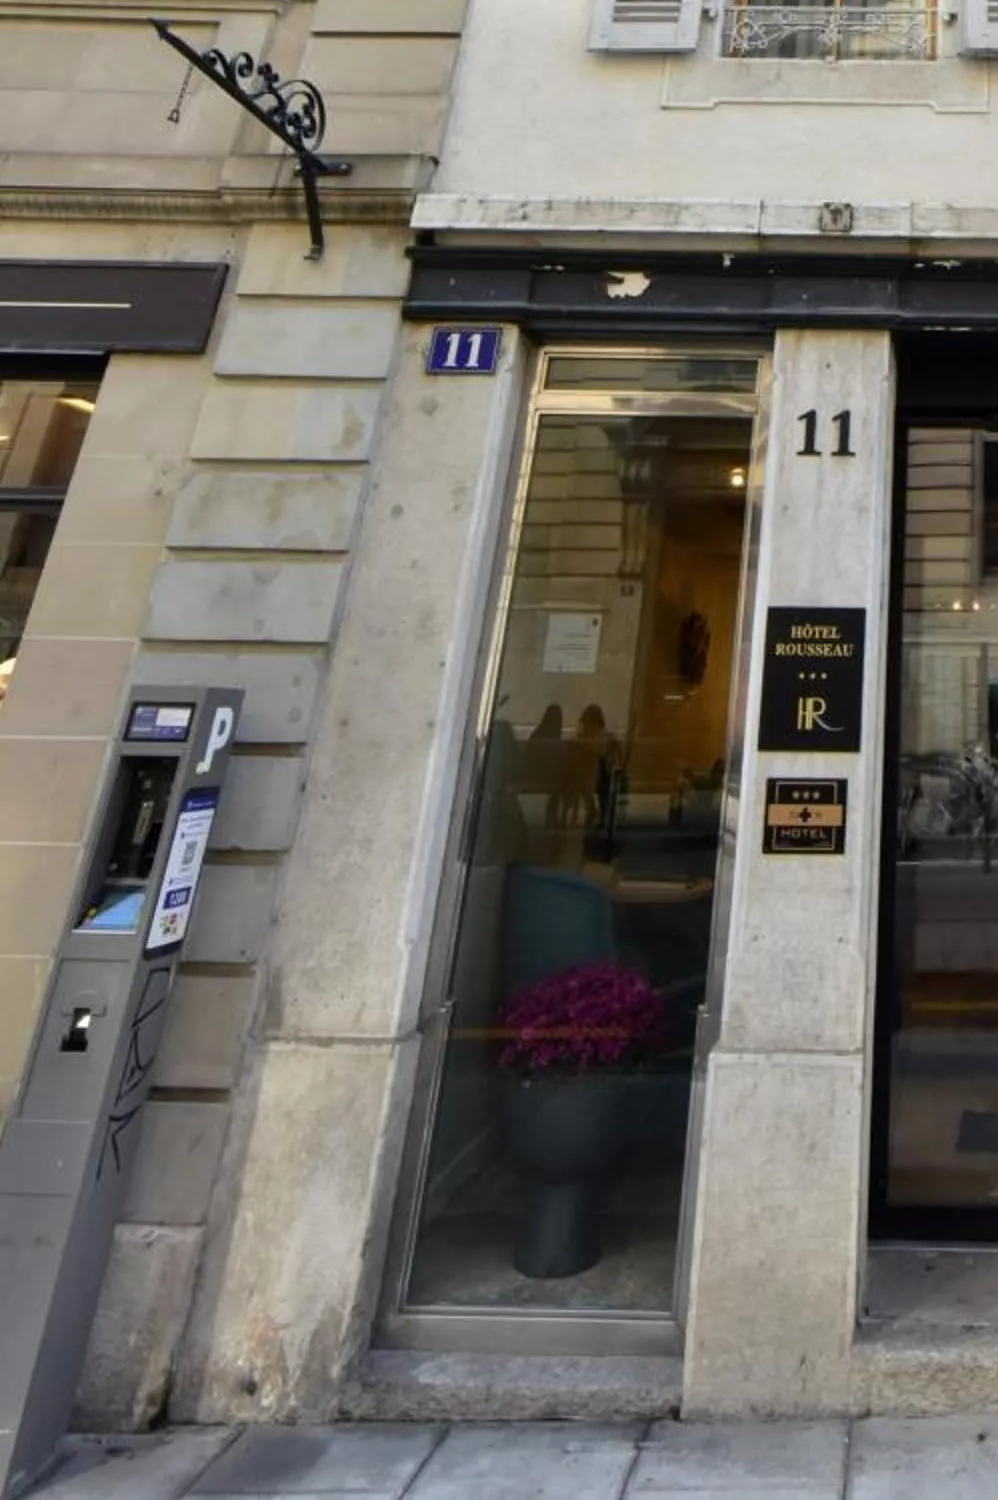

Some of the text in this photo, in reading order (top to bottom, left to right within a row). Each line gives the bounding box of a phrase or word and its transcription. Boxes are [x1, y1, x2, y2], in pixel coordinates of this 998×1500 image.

[442, 333, 483, 368] 11
[796, 408, 857, 457] 11
[791, 623, 841, 639] HÔTEL
[775, 642, 855, 657] ROUSSEAU
